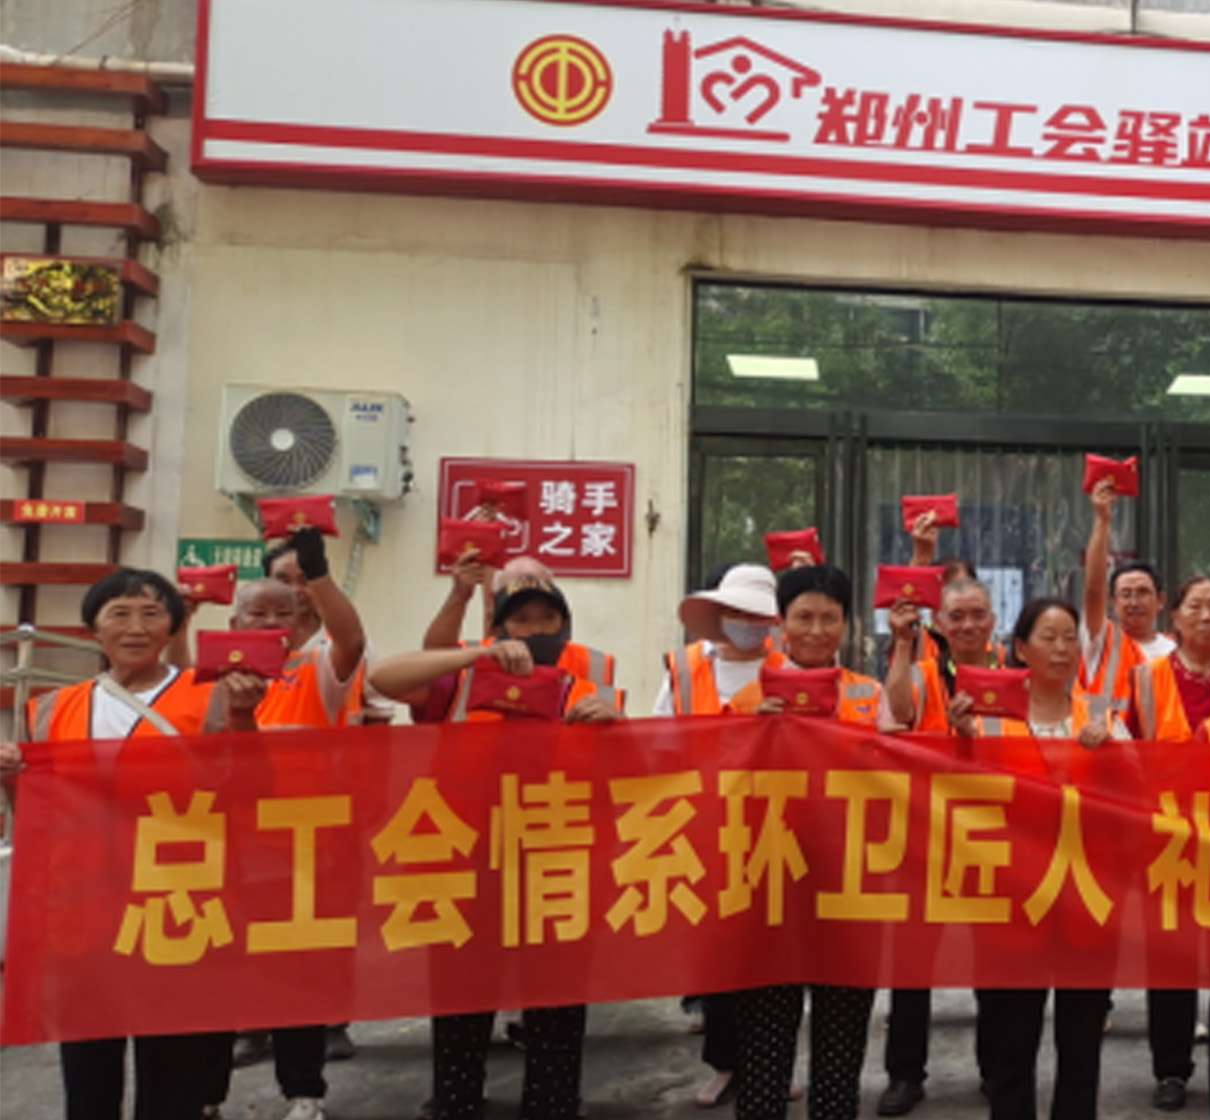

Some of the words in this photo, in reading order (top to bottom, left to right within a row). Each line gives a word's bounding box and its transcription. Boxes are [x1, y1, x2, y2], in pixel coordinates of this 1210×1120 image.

[538, 480, 618, 516] 骑手
[538, 520, 617, 557] 之家
[113, 770, 1114, 966] 总工会情系环卫匠人
